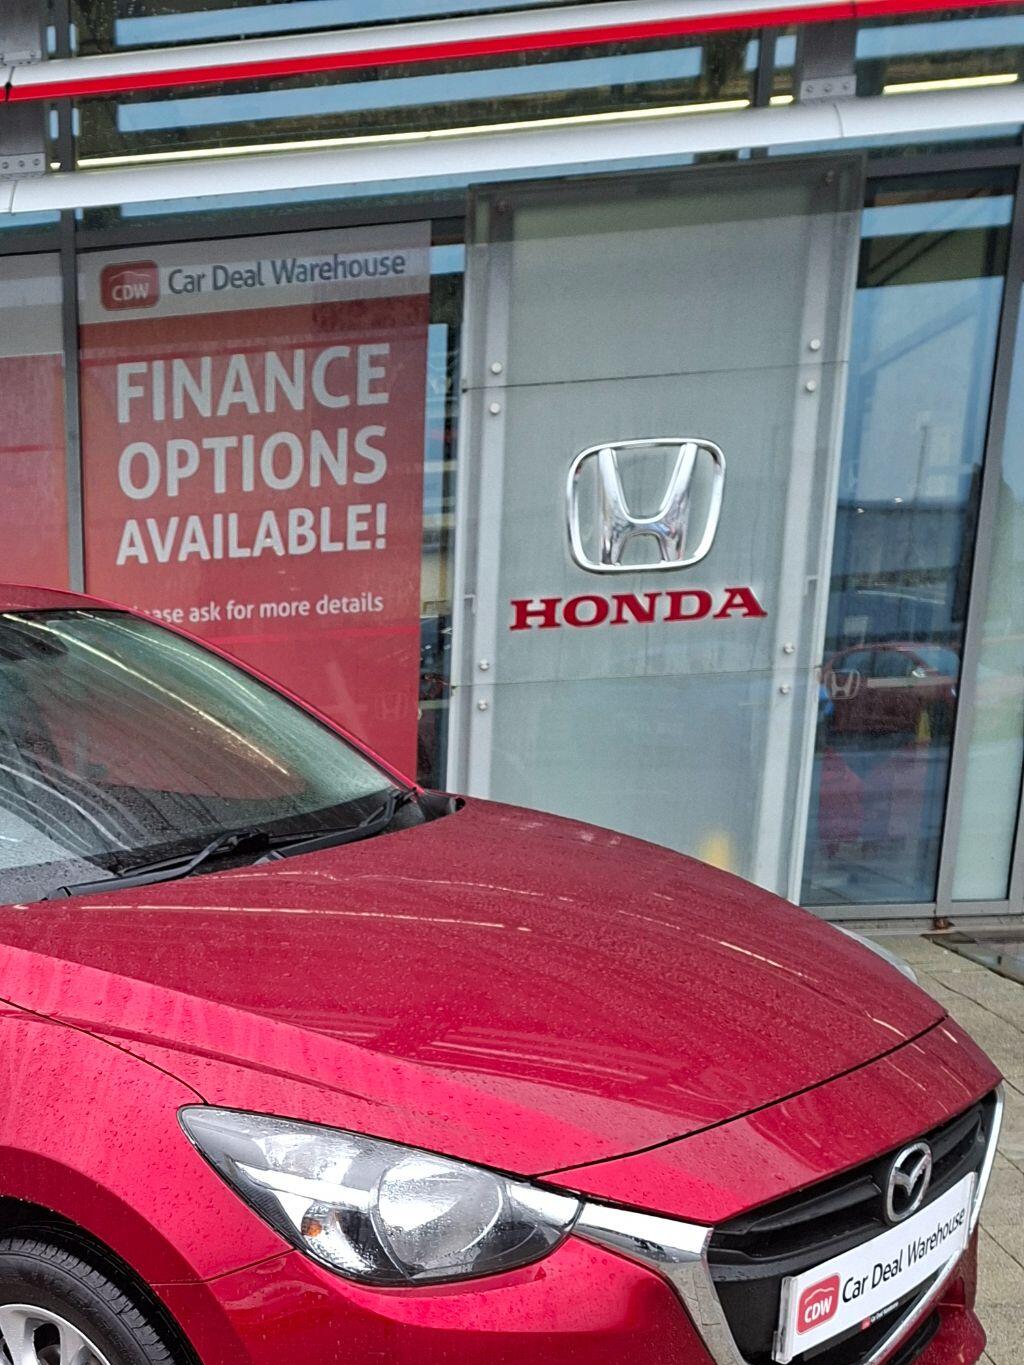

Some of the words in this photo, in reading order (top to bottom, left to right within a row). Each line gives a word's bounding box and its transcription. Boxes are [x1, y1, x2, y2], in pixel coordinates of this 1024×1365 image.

[111, 282, 150, 302] CDW
[168, 267, 205, 295] Car
[212, 261, 264, 291] Deal
[271, 252, 406, 285] Warehouse
[116, 342, 391, 424] FINANCE
[117, 424, 388, 500] OPTIONS
[115, 502, 389, 567] AVAILABLE!
[133, 606, 184, 623] ase
[188, 601, 221, 623] ask
[226, 599, 254, 621] for
[259, 599, 310, 618] more
[316, 592, 384, 615] details
[509, 586, 768, 631] HONDA
[841, 1274, 869, 1303] Car
[871, 1249, 904, 1290] Deal
[907, 1207, 965, 1268] Warehouse
[804, 1295, 833, 1324] CDW
